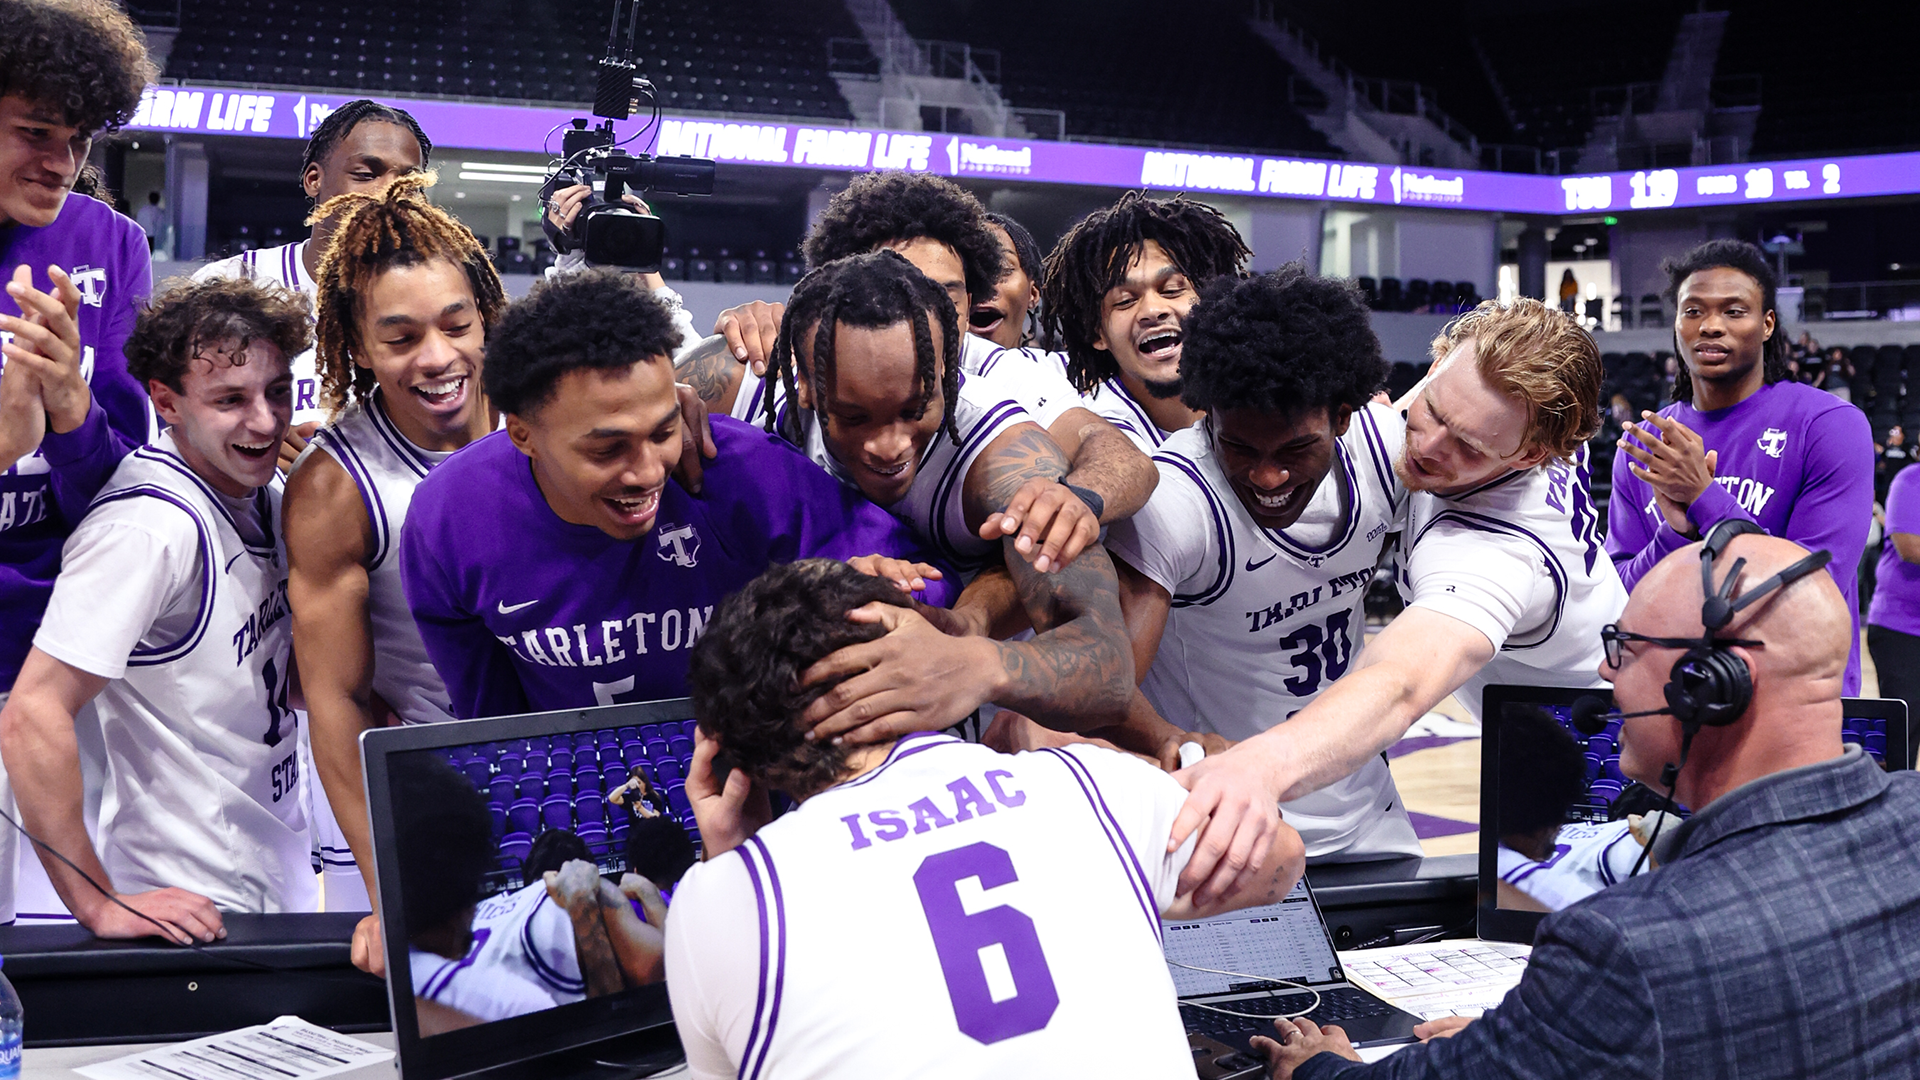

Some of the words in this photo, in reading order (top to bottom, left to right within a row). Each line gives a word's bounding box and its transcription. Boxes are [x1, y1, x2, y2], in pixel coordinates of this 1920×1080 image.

[206, 93, 275, 133] LIFE
[656, 120, 788, 163] NATIONAL
[792, 128, 872, 168] FARM
[872, 133, 933, 171] LIFE
[1140, 151, 1256, 191] NATIONAL
[1258, 159, 1327, 196] FARM
[1327, 164, 1379, 199] LIFE
[1822, 163, 1841, 194] 2
[1245, 566, 1378, 633] TARLETO
[1279, 607, 1353, 698] 30
[839, 768, 1028, 852] ISAAC
[912, 840, 1061, 1047] 6
